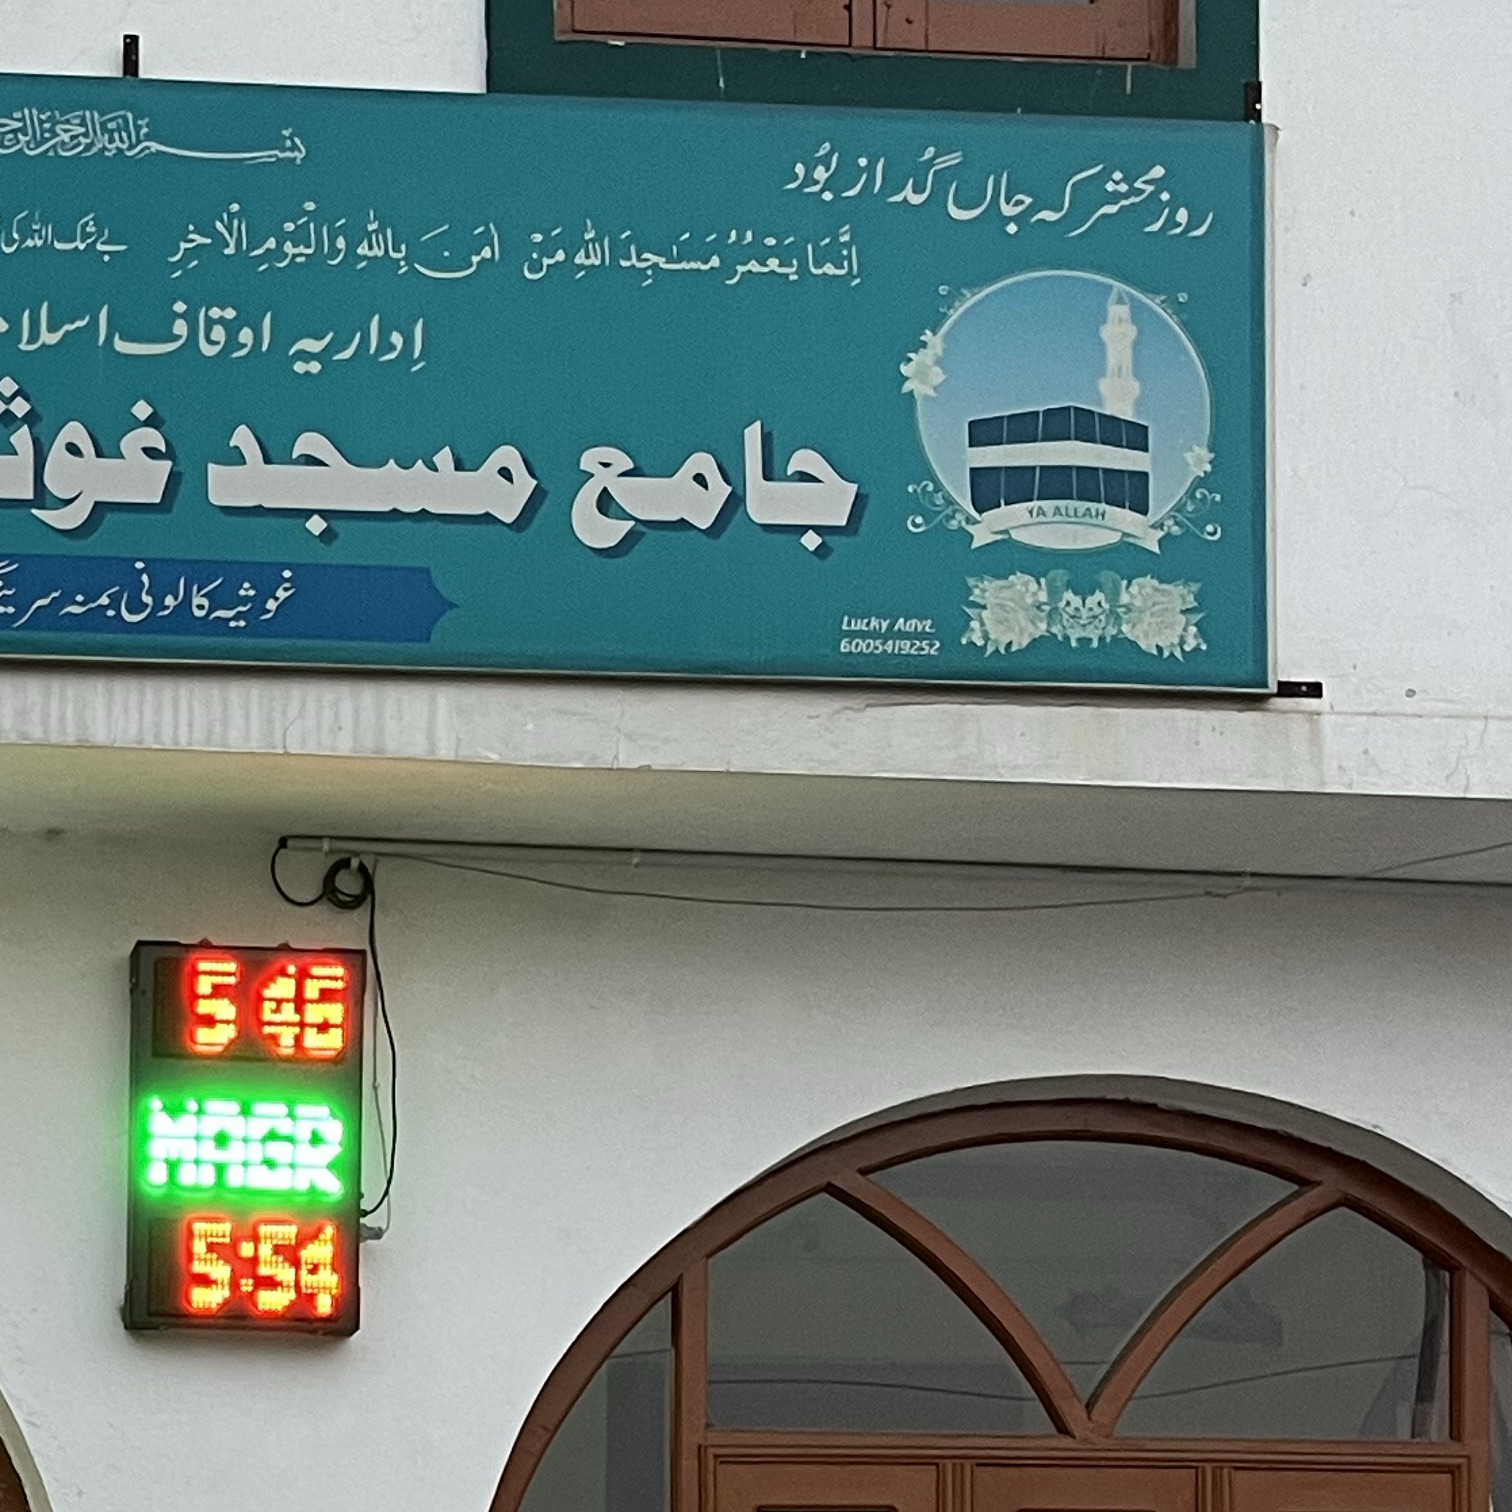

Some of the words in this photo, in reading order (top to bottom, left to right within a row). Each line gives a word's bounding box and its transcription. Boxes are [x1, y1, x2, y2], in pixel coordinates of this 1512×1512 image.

[0, 210, 30, 255] کی
[113, 300, 273, 359] اوقاف
[207, 423, 539, 537] مسجد
[571, 419, 859, 552] جامع
[1026, 505, 1047, 519] YA
[1052, 506, 1107, 522] ALLAH
[120, 561, 223, 623] کالونی
[208, 569, 297, 628] غوثیہ
[839, 637, 941, 656] 6005419252
[188, 1220, 341, 1315] 5:54
